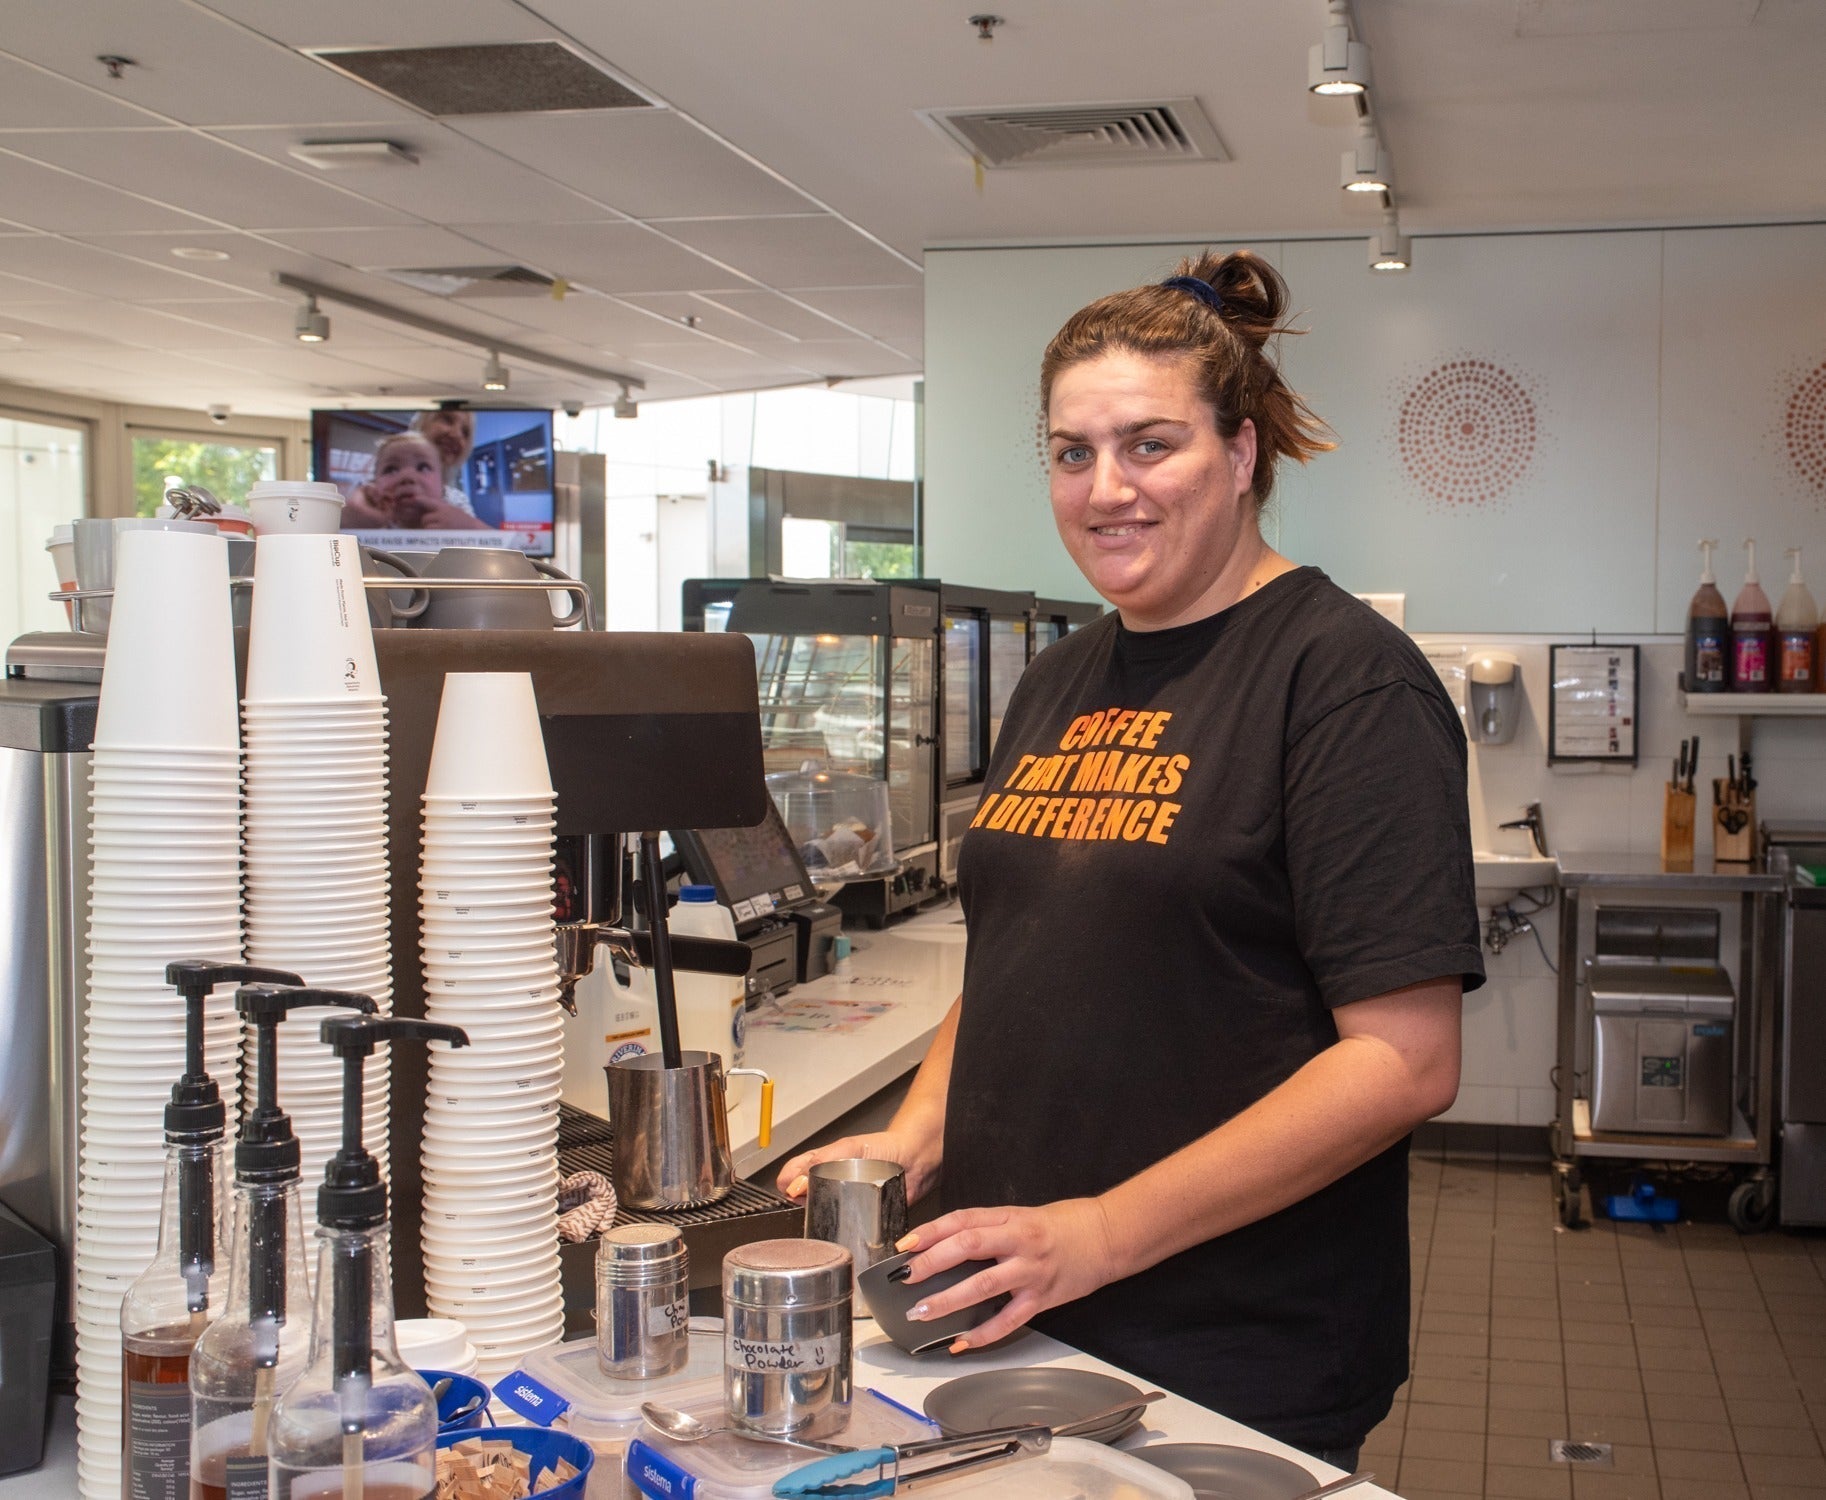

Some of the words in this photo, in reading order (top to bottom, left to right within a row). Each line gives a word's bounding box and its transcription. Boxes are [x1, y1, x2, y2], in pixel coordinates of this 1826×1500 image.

[406, 535, 440, 546] IMPACTS
[1059, 708, 1172, 751] COFFEE
[1004, 754, 1080, 792] THAT
[1070, 750, 1191, 795] MAKES
[969, 794, 1000, 829] A
[986, 795, 1182, 845] DIFFERENCE
[611, 1043, 647, 1063] RIVERIN
[745, 1353, 804, 1370] Powder
[514, 1385, 544, 1407] sistema
[643, 1464, 672, 1494] sistema
